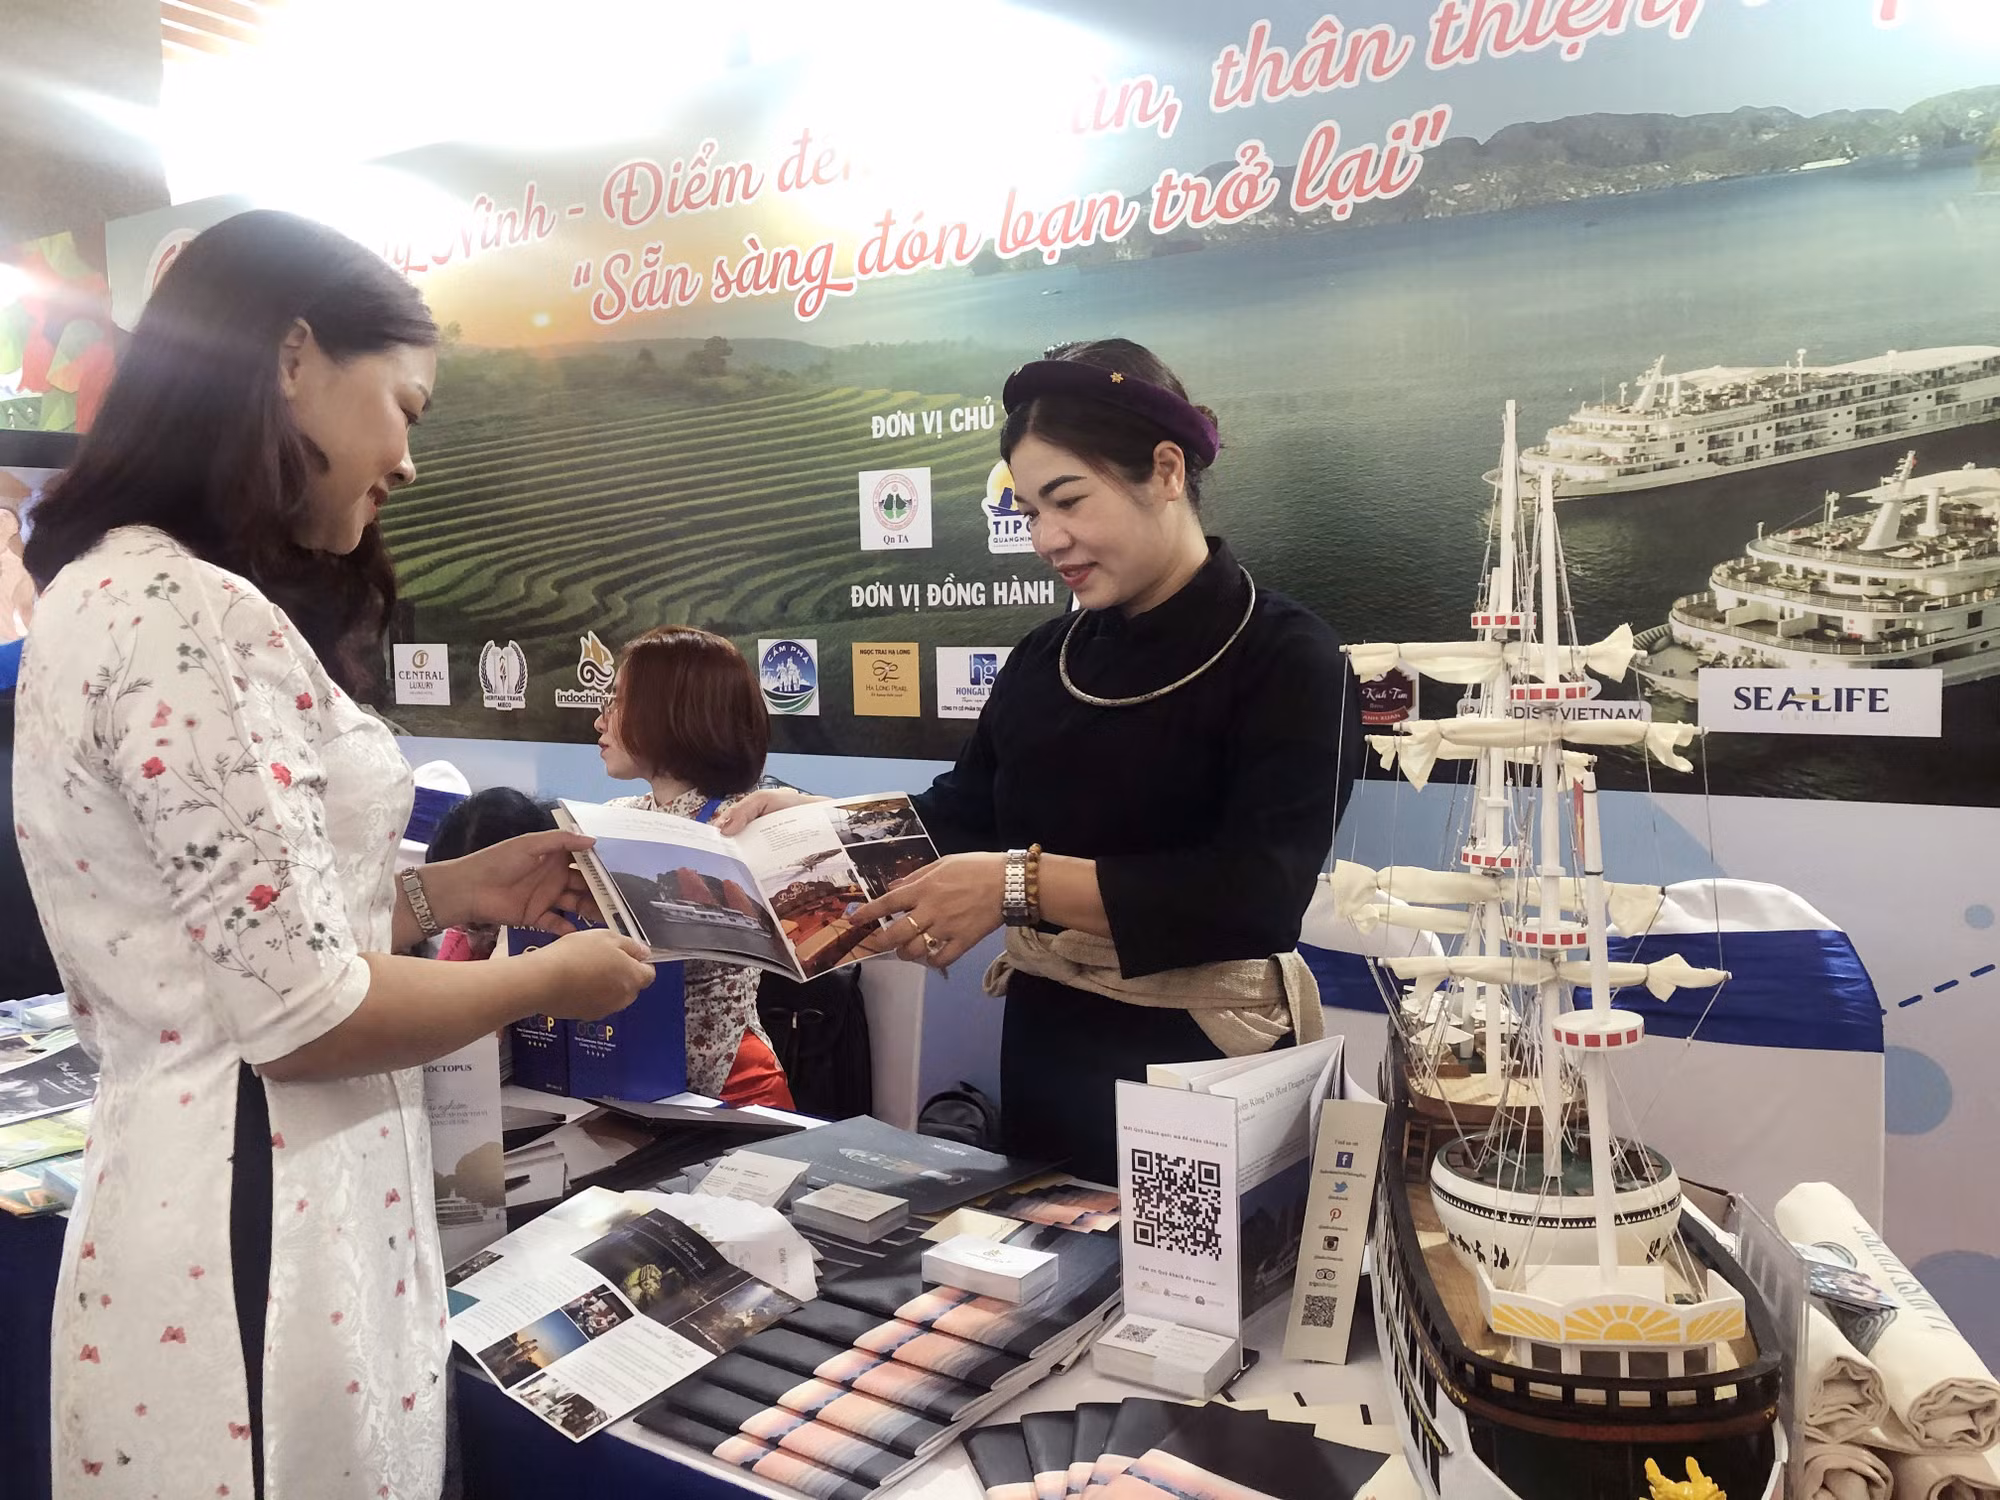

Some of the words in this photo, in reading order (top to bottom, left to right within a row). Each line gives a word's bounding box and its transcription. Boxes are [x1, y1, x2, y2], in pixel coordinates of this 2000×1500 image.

[604, 142, 764, 226] Điểm
[1212, 20, 1410, 109] thân
[714, 238, 855, 319] sàng
[858, 207, 982, 274] đón
[1000, 187, 1138, 262] bạn
[1153, 144, 1275, 229] trở
[871, 410, 915, 438] ĐƠN
[922, 410, 943, 439] VỊ
[950, 396, 995, 432] CHỦ
[851, 581, 893, 607] ĐƠN
[900, 583, 920, 611] VỊ
[927, 573, 986, 606] ĐỒNG
[993, 575, 1055, 604] HÀNH
[398, 670, 445, 680] CENTRAL
[556, 692, 602, 703] indochin
[1559, 706, 1644, 721] VIETNAM
